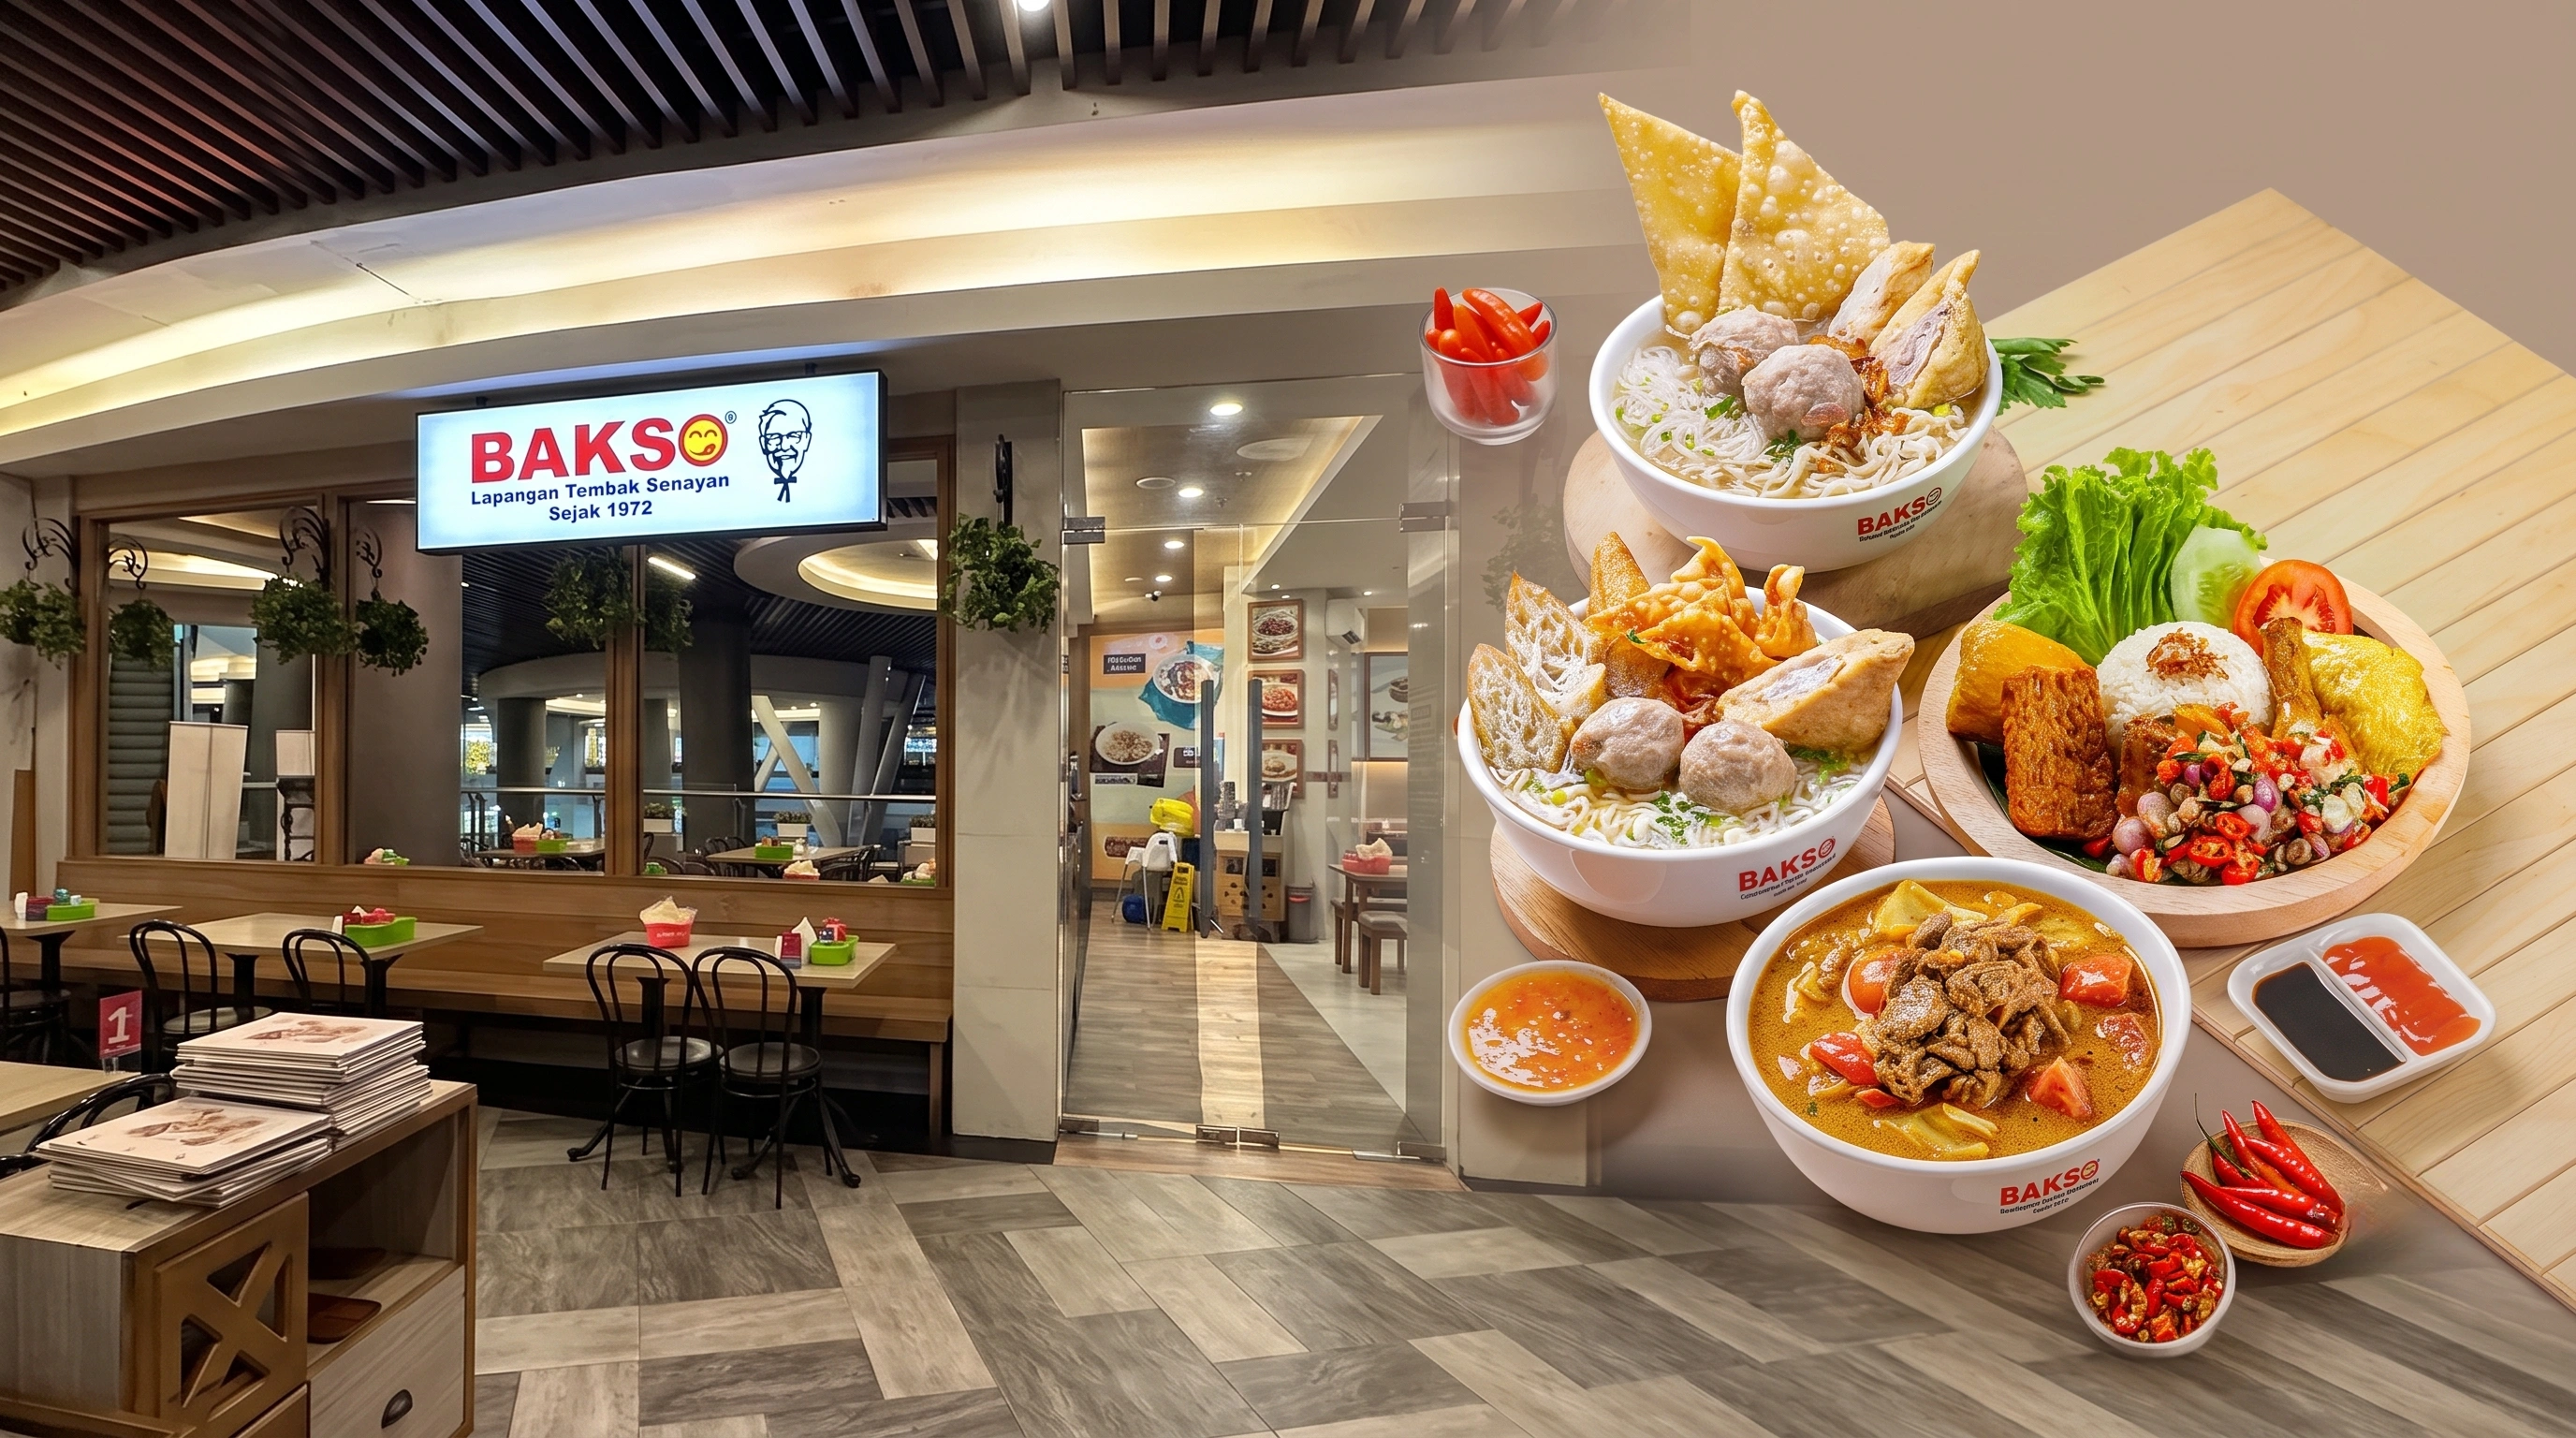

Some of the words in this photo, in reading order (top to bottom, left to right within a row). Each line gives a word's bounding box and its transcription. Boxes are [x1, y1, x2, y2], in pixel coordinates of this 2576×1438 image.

[471, 413, 729, 484] BAKSO
[471, 488, 560, 506] Lapangan
[564, 478, 641, 498] Tembak
[646, 476, 730, 493] Senayan
[549, 504, 601, 523] Sejak
[607, 500, 653, 518] 1972
[1857, 487, 1942, 536] BAKSO
[1738, 838, 1837, 892] BAKSO
[108, 1006, 131, 1044] 1
[1999, 1159, 2100, 1207] BAKSO
